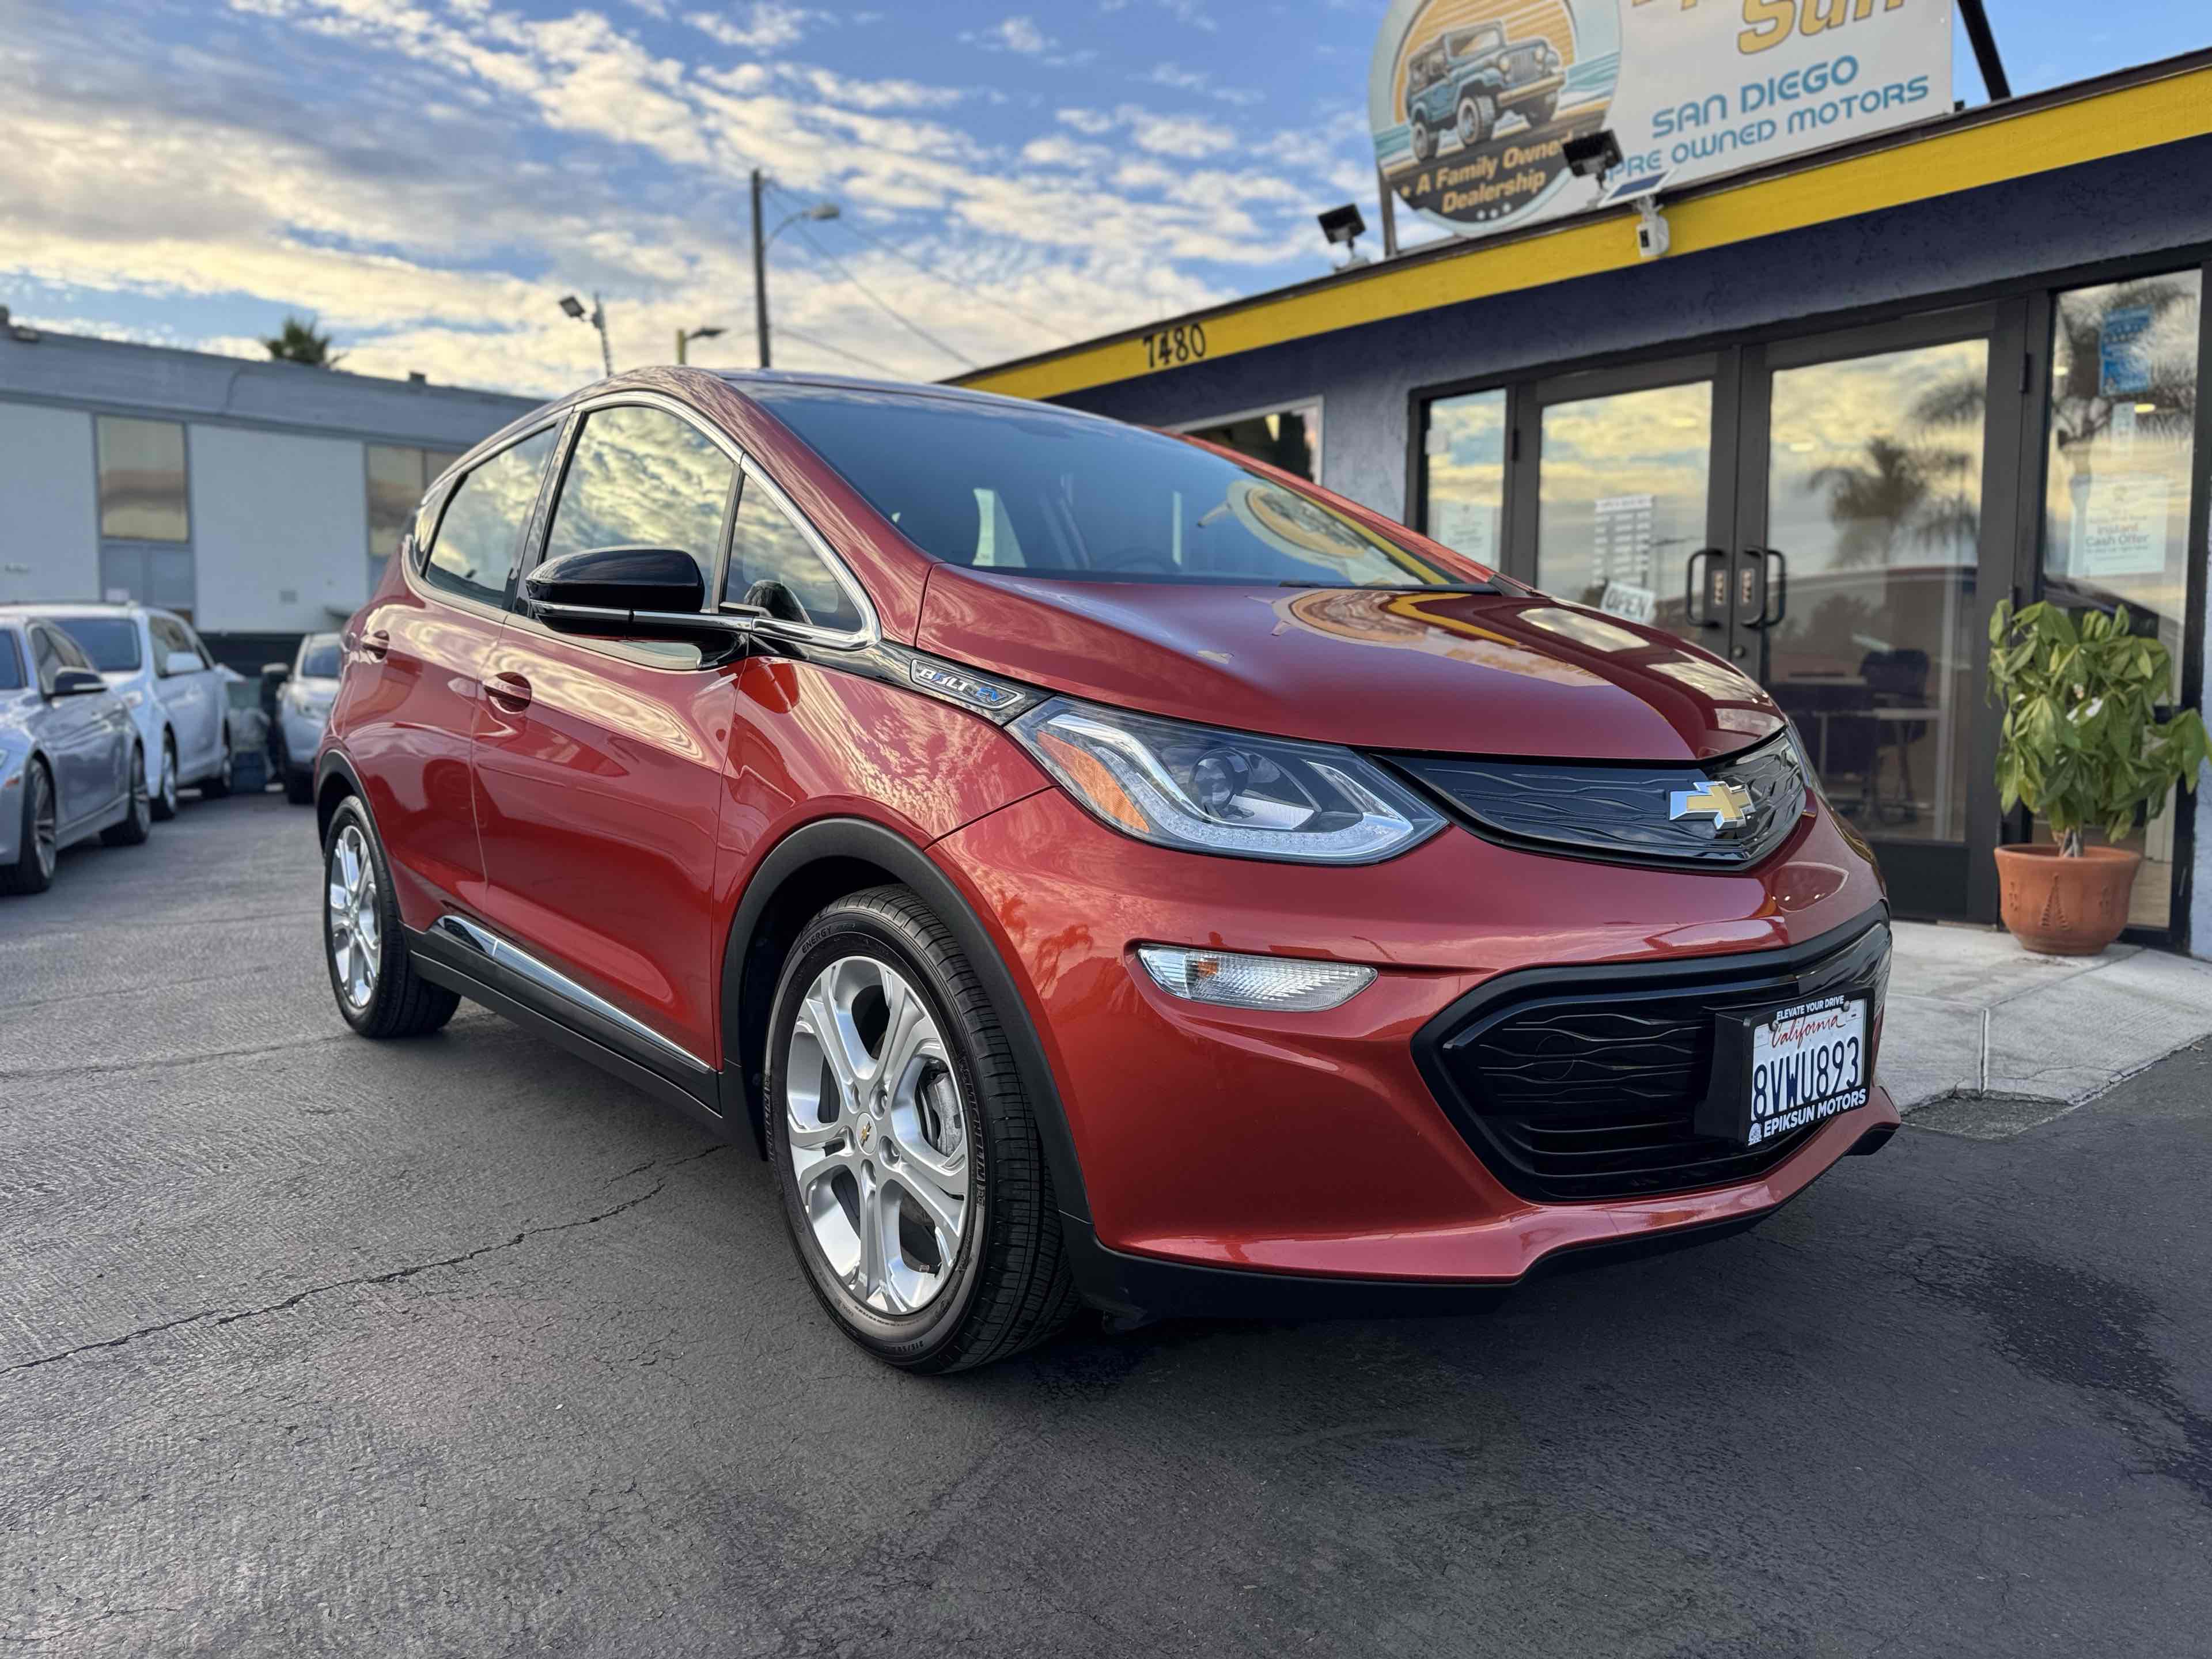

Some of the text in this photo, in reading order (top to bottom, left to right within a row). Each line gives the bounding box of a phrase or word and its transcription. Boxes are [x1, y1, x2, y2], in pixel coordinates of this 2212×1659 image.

[1652, 55, 1858, 138] SAN DIEGO
[1671, 119, 1777, 164] OWNED
[1787, 75, 1929, 135] MOTORS
[1416, 173, 1431, 195] A
[1436, 155, 1497, 190] Family
[1442, 171, 1546, 213] Dealership
[1143, 323, 1206, 368] 7480
[919, 668, 968, 691] BOLT
[801, 926, 832, 954] ENERGY
[1776, 995, 1844, 1020] ELEVATE YOUR DRIVE
[1771, 1014, 1846, 1050] California
[1753, 1036, 1859, 1119] 8VWU893
[1763, 1088, 1866, 1138] EPIKSUN MOTORS
